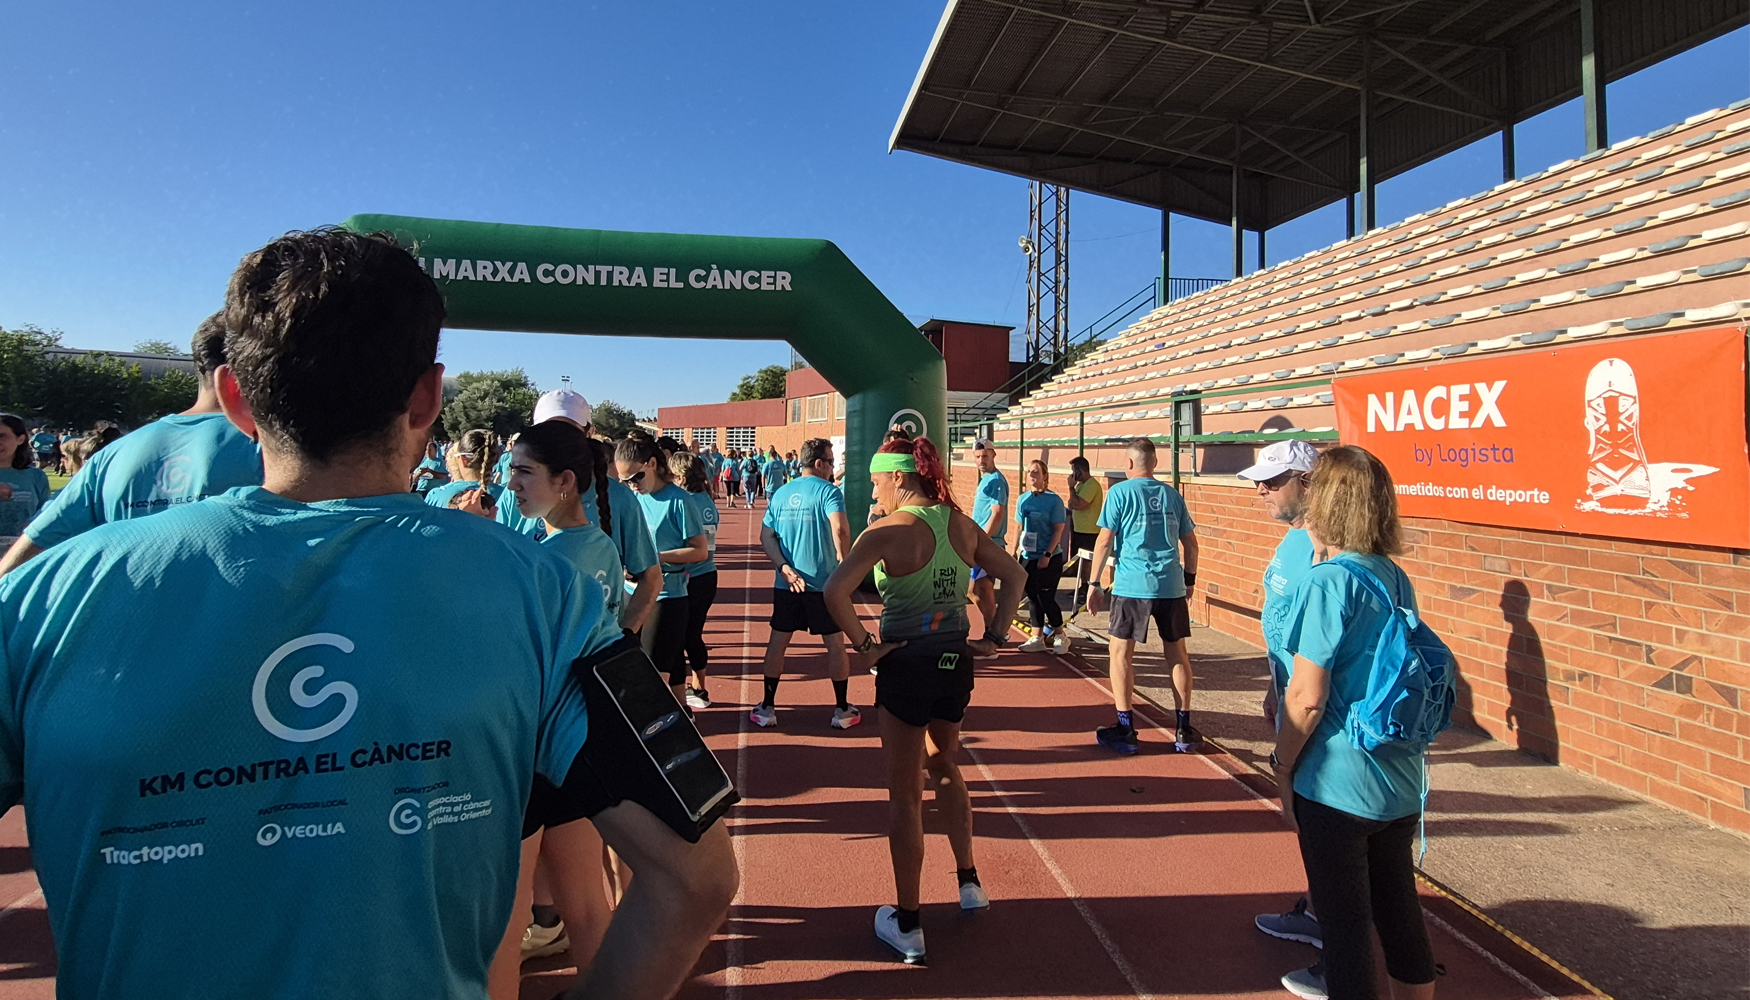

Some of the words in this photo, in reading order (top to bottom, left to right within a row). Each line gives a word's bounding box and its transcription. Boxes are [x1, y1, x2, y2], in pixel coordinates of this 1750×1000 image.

[433, 258, 531, 283] MARXA
[536, 263, 648, 287] CONTRA
[653, 267, 684, 288] EL
[688, 264, 792, 291] CÀNCER
[1367, 380, 1508, 433] NACEX
[1414, 443, 1433, 467] by
[1393, 482, 1444, 497] ometidos
[1446, 486, 1469, 499] con
[1472, 485, 1484, 500] el
[1487, 485, 1550, 505] deporte
[933, 577, 957, 589] WITH
[940, 566, 957, 577] RUN
[140, 772, 185, 797] KM
[193, 757, 310, 789] CONTRA
[315, 752, 345, 774] EL
[351, 741, 452, 768] CÀNCER
[284, 822, 346, 839] VEOLIA
[101, 842, 204, 865] Tractopon
